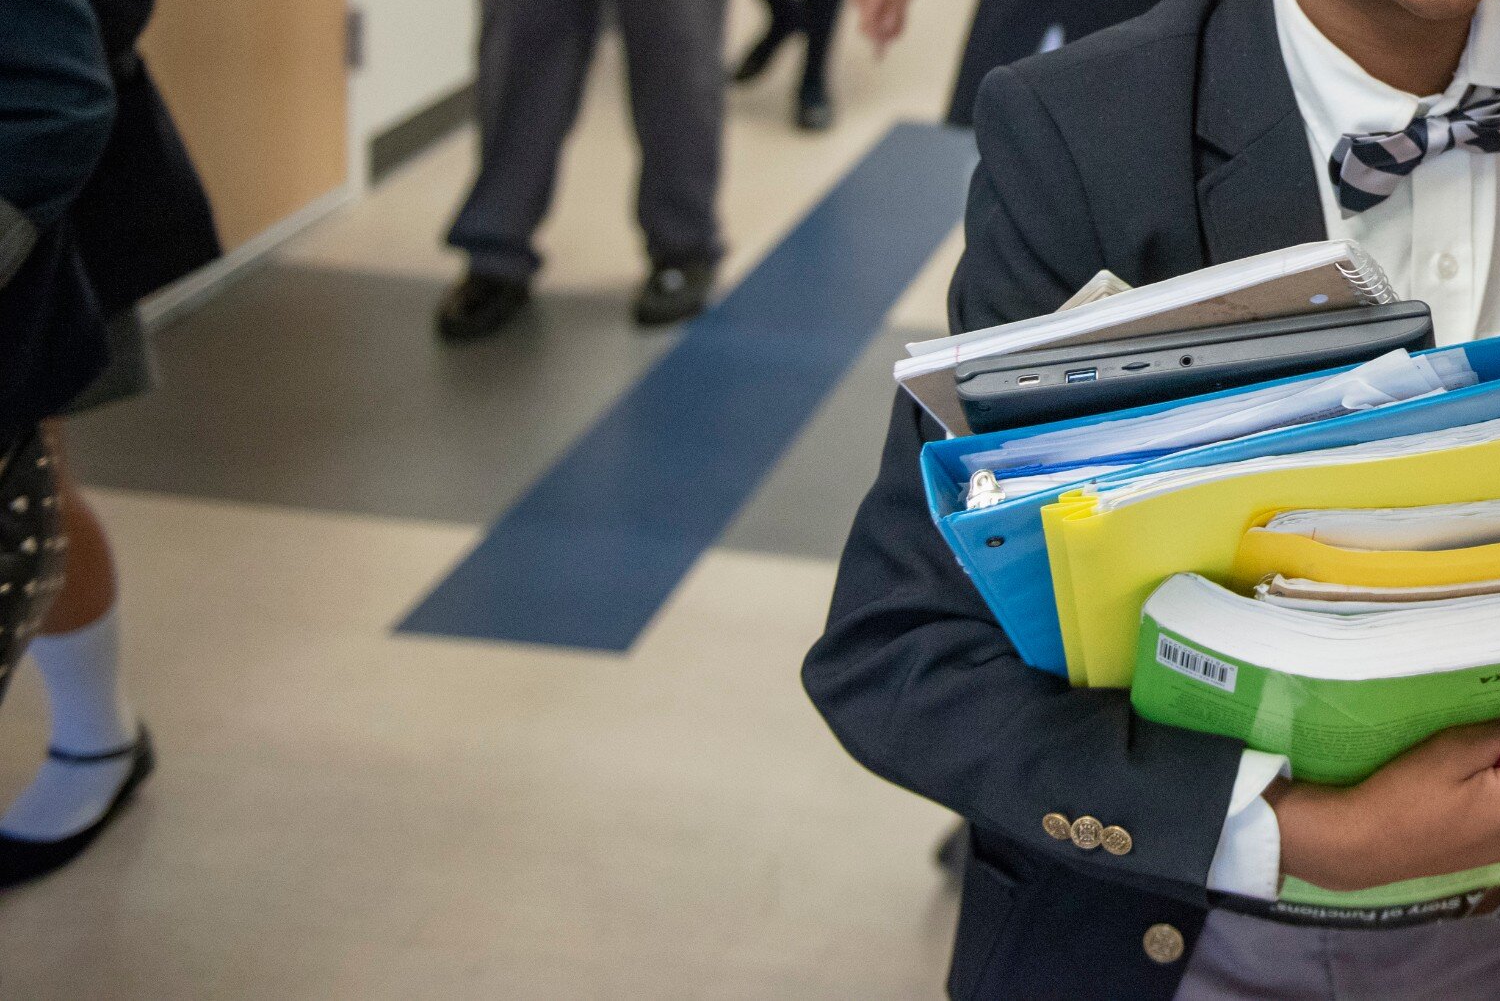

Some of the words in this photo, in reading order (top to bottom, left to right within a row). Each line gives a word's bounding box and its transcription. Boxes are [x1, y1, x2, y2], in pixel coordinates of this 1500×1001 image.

[1406, 896, 1461, 916] Story
[1466, 891, 1485, 909] A
[1382, 907, 1404, 921] of
